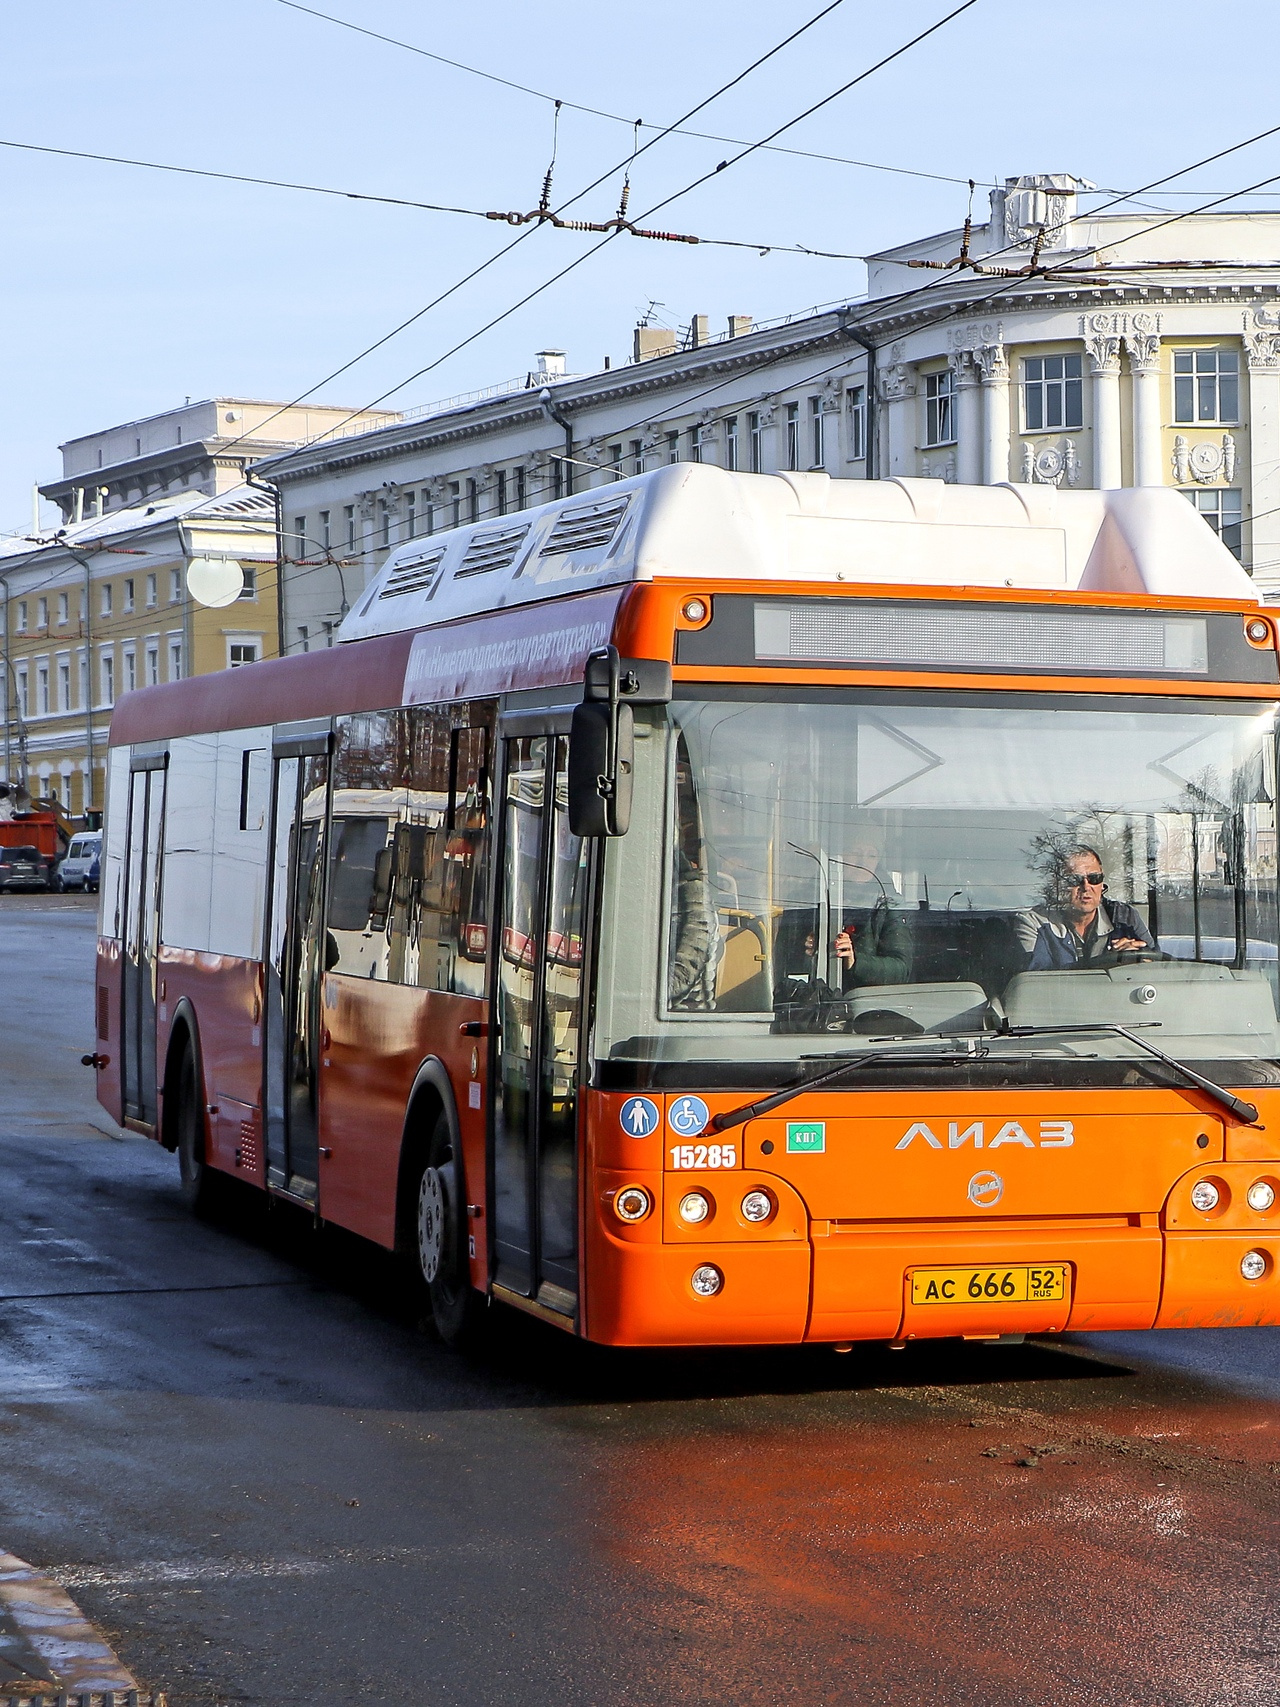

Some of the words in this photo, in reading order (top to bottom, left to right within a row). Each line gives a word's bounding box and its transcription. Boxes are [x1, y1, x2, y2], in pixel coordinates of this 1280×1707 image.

[795, 1132, 817, 1143] КПГ
[894, 1121, 1075, 1150] ЛИАЗ
[670, 1144, 736, 1169] 15285
[968, 1272, 1016, 1298] 666
[1031, 1270, 1055, 1289] 52
[1033, 1290, 1052, 1298] RUS
